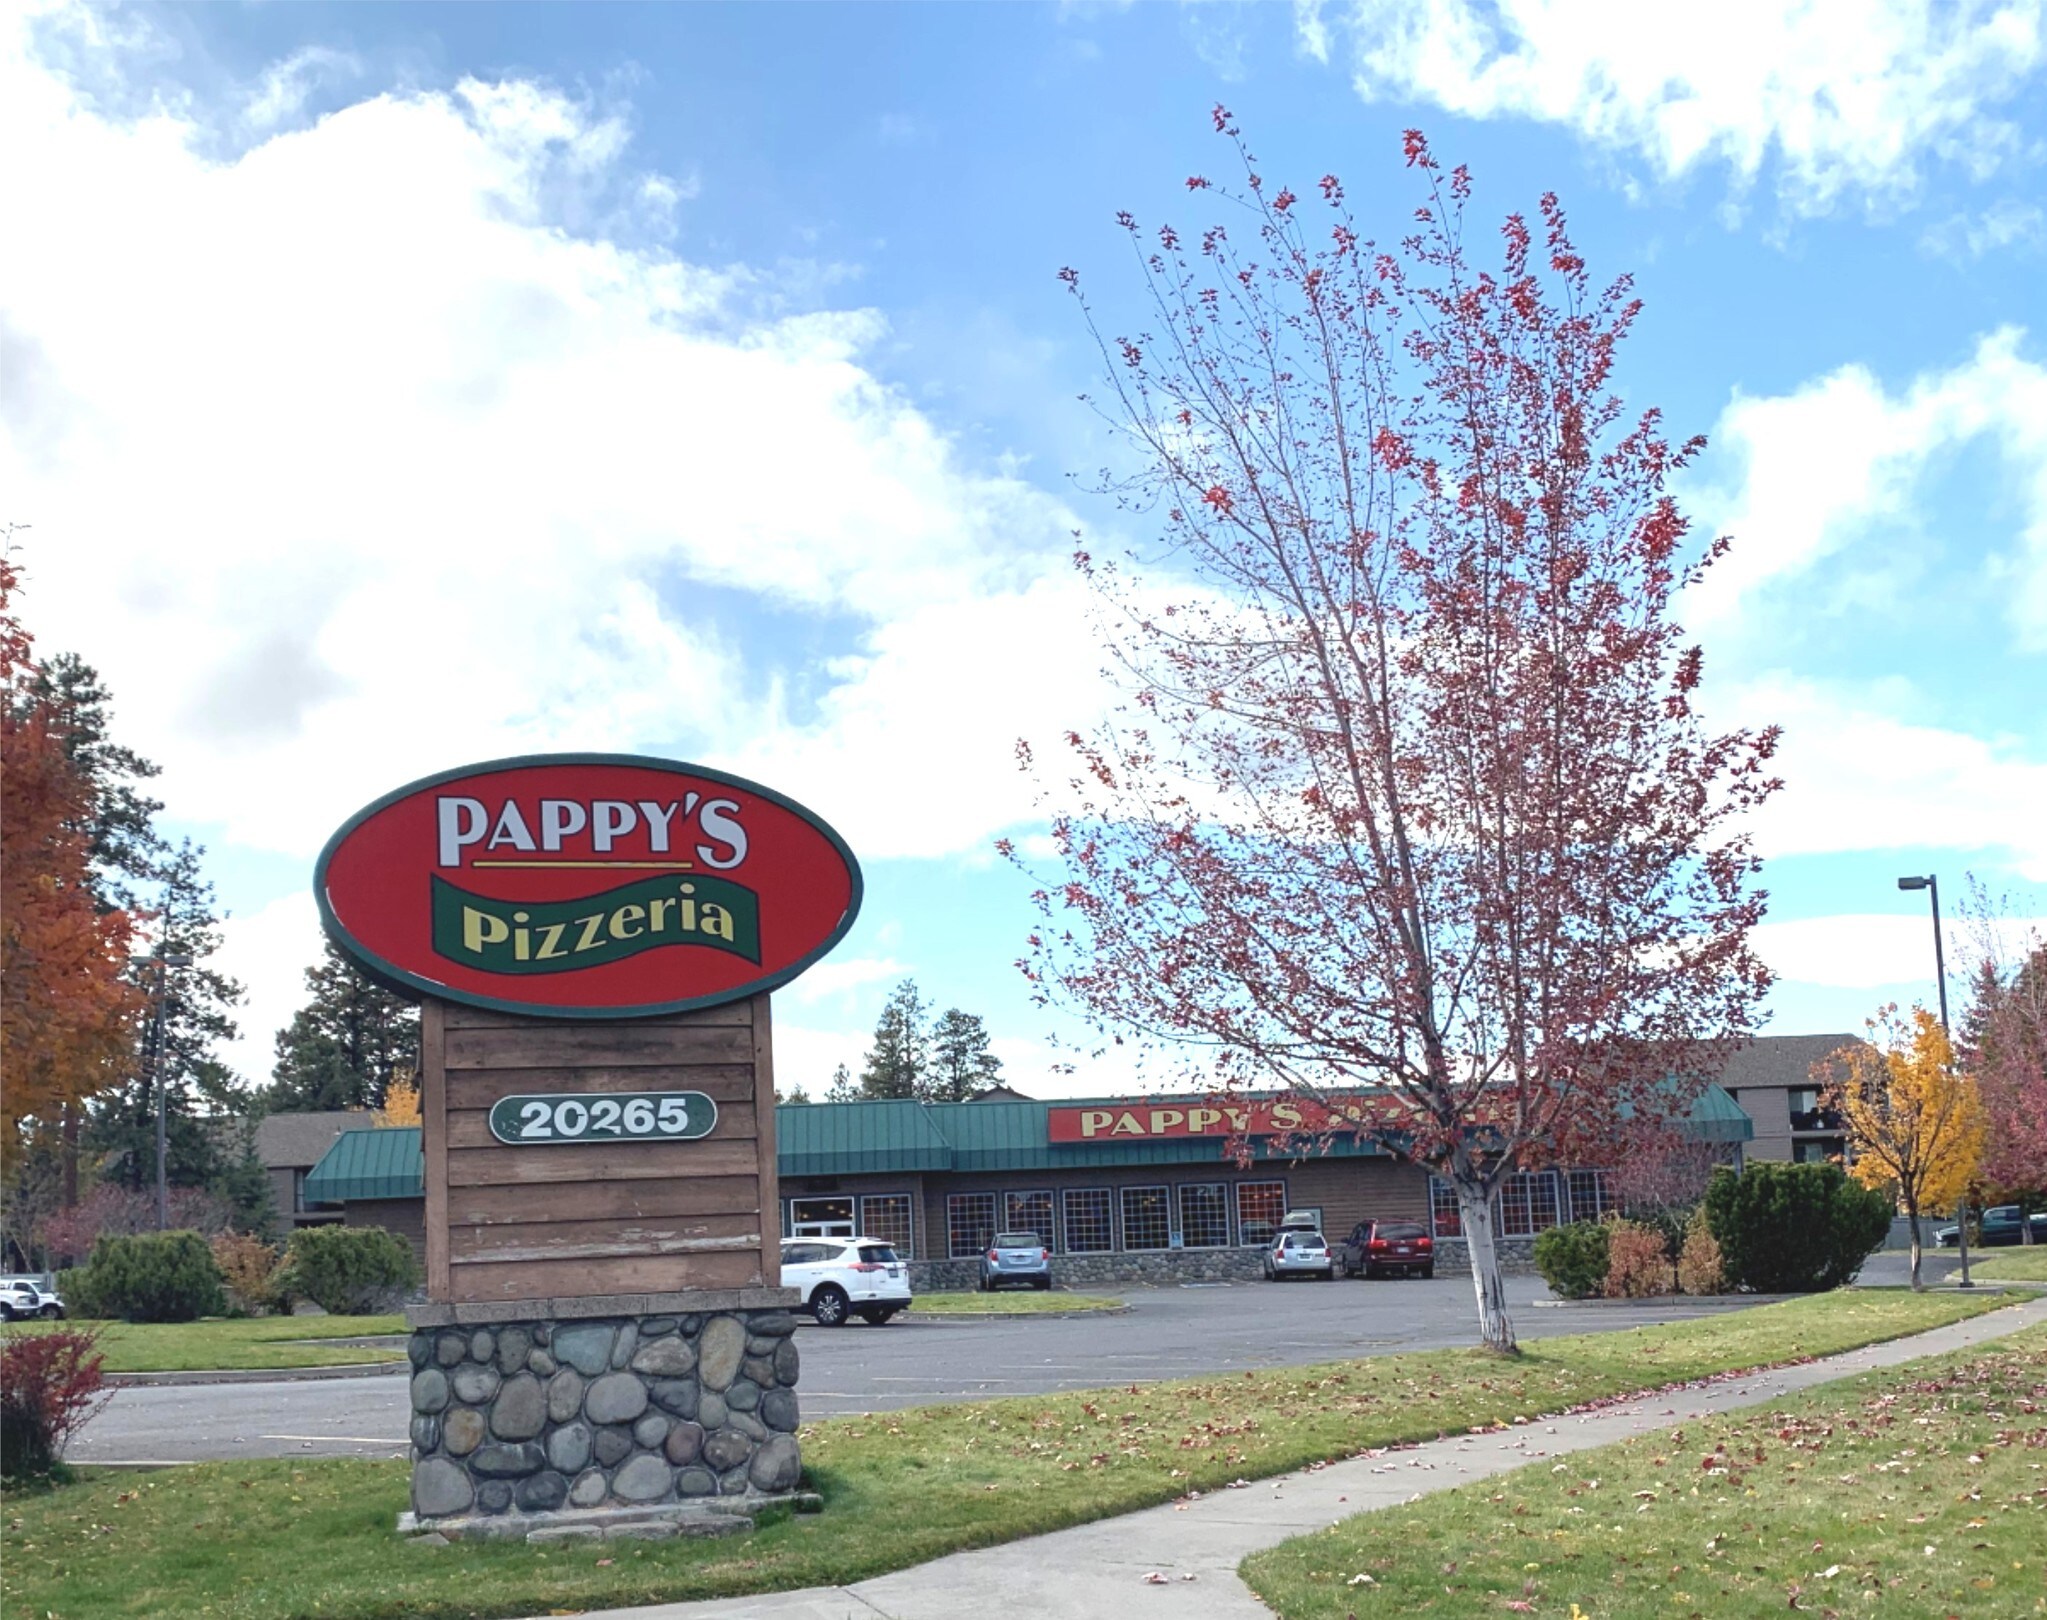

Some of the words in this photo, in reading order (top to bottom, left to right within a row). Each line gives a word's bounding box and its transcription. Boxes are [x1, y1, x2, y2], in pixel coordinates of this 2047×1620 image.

[437, 792, 749, 869] PAPPY'S
[463, 883, 734, 961] Pizzeria
[520, 1098, 689, 1137] 20265
